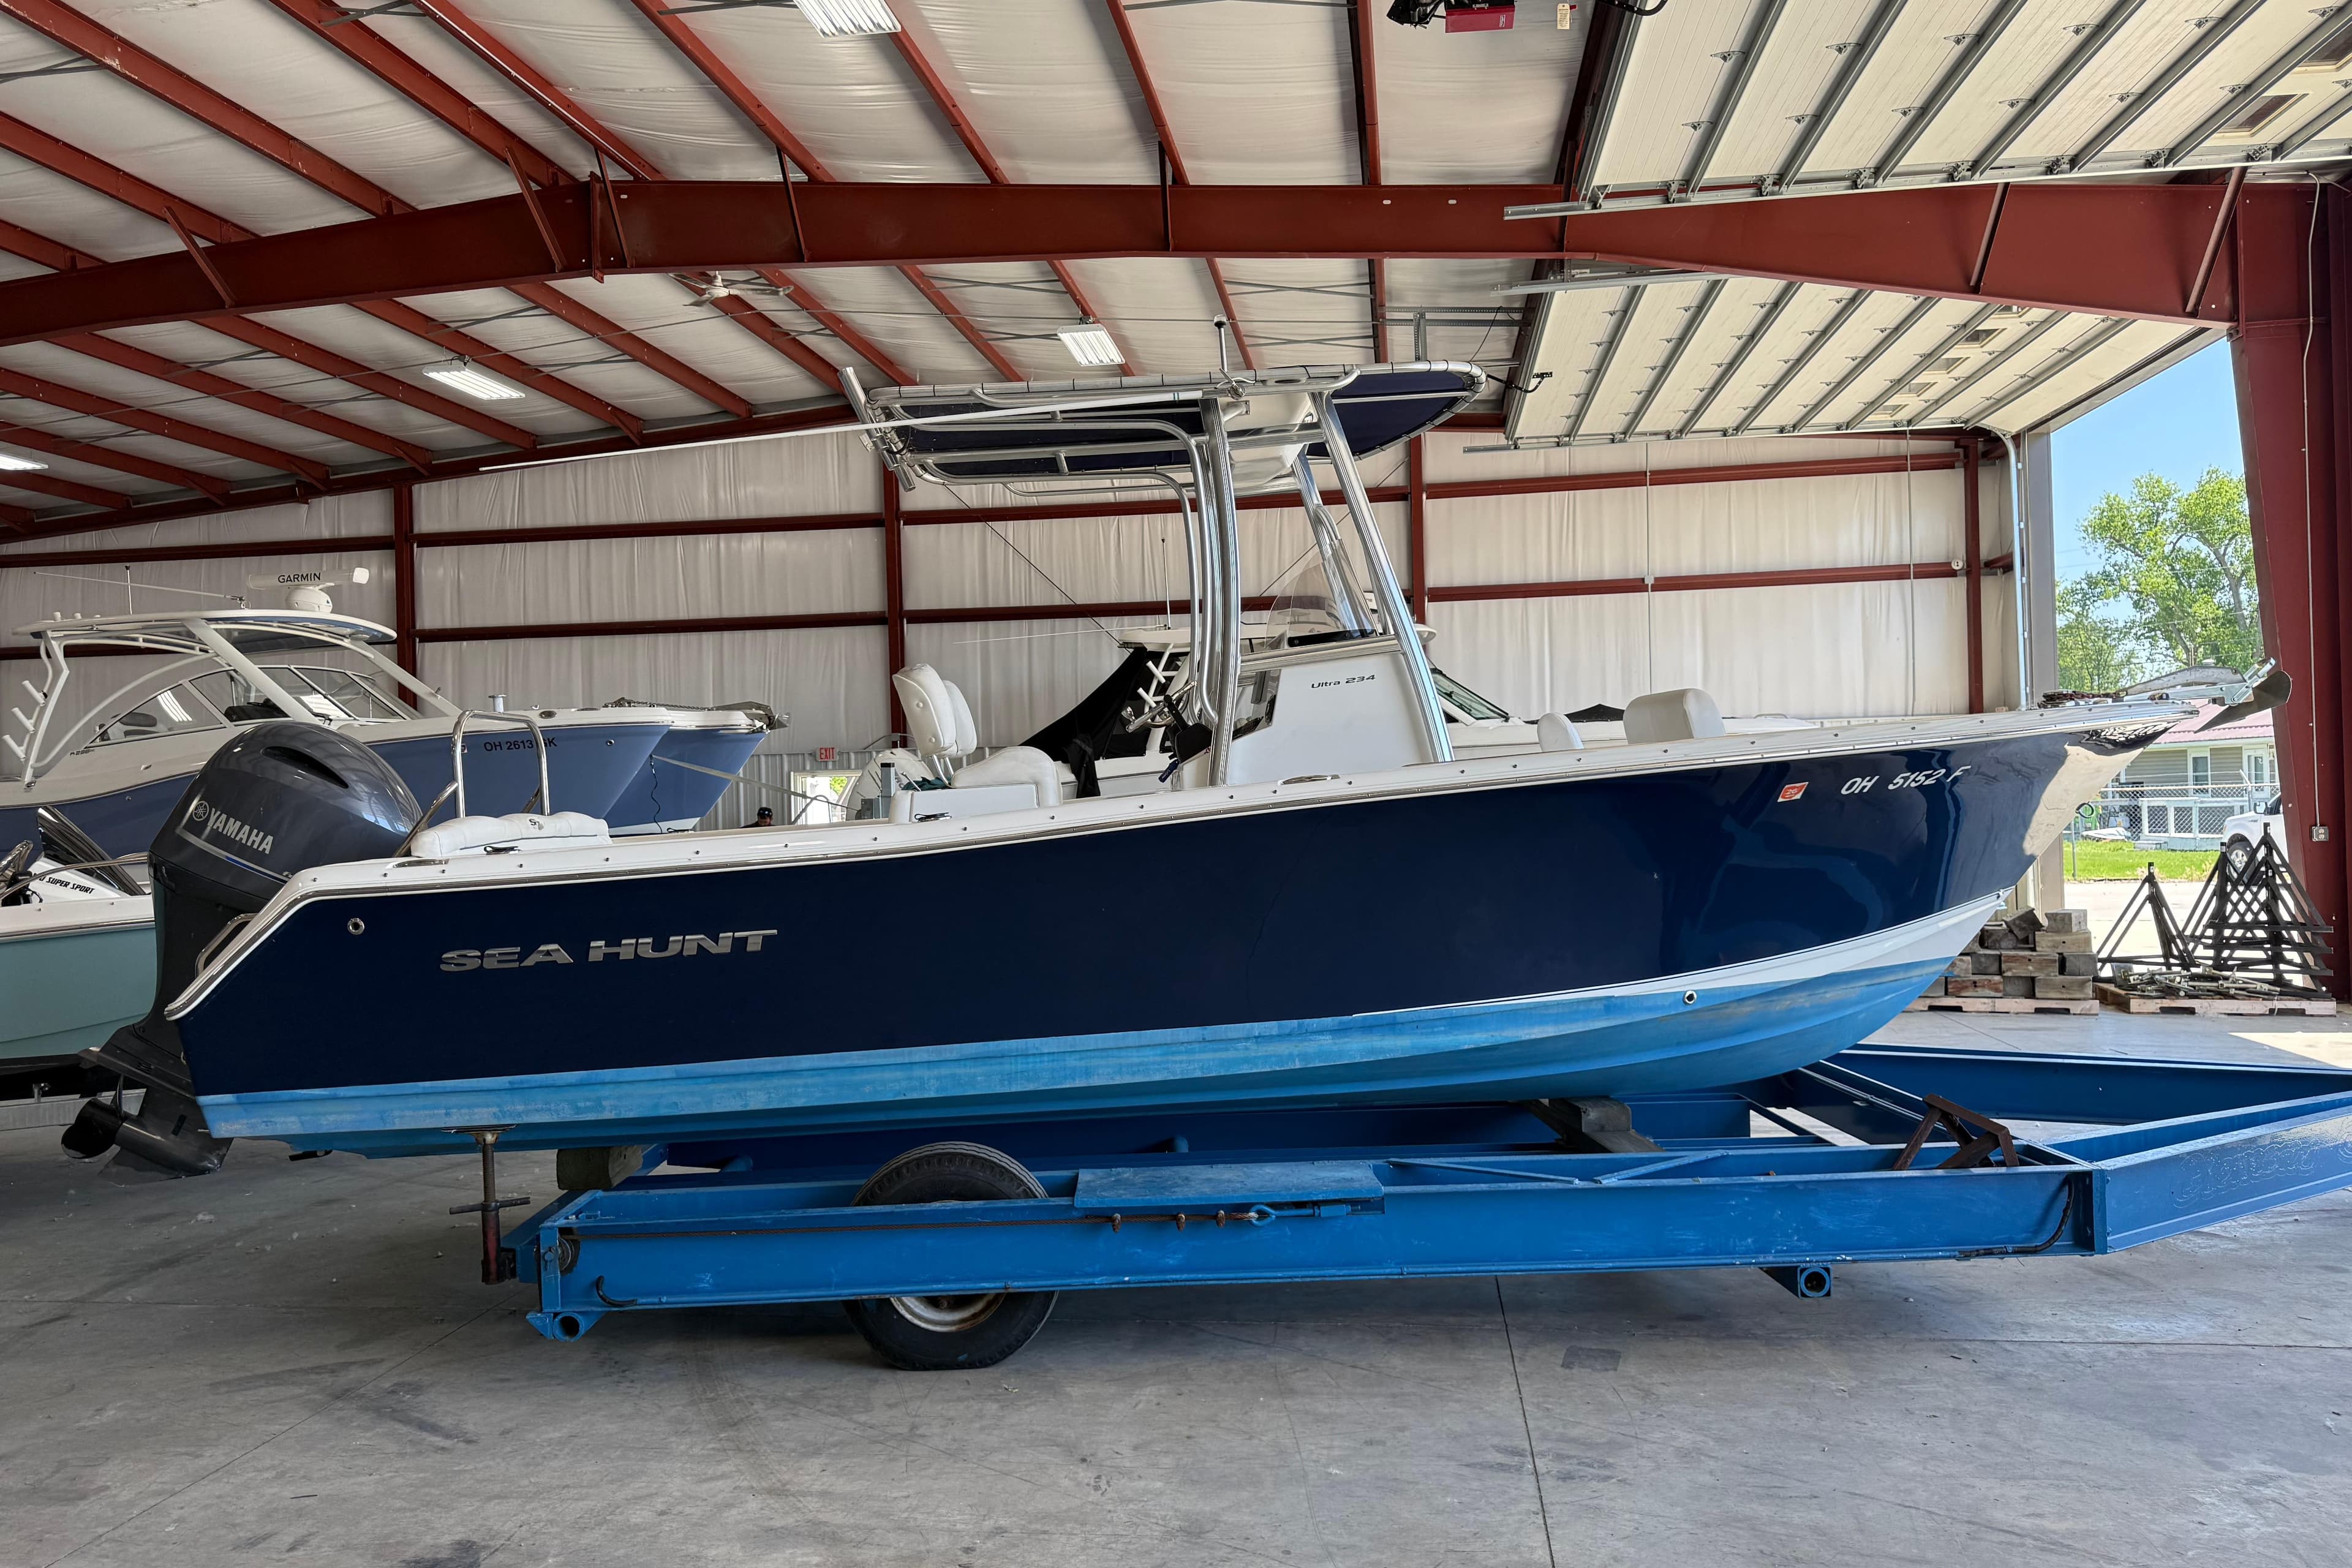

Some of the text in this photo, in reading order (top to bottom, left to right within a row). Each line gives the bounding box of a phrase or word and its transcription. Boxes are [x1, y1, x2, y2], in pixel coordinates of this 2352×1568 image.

[278, 573, 321, 583] GARMIN
[1346, 675, 1375, 684] 234
[484, 741, 502, 752] OH
[506, 739, 533, 750] 2613
[820, 747, 834, 760] EXIT
[1841, 765, 1971, 794] OH 5152 F
[208, 807, 273, 854] YAMAHA
[46, 877, 70, 888] SUPER
[70, 883, 96, 894] SPORT
[440, 930, 778, 971] SEA HUNT
